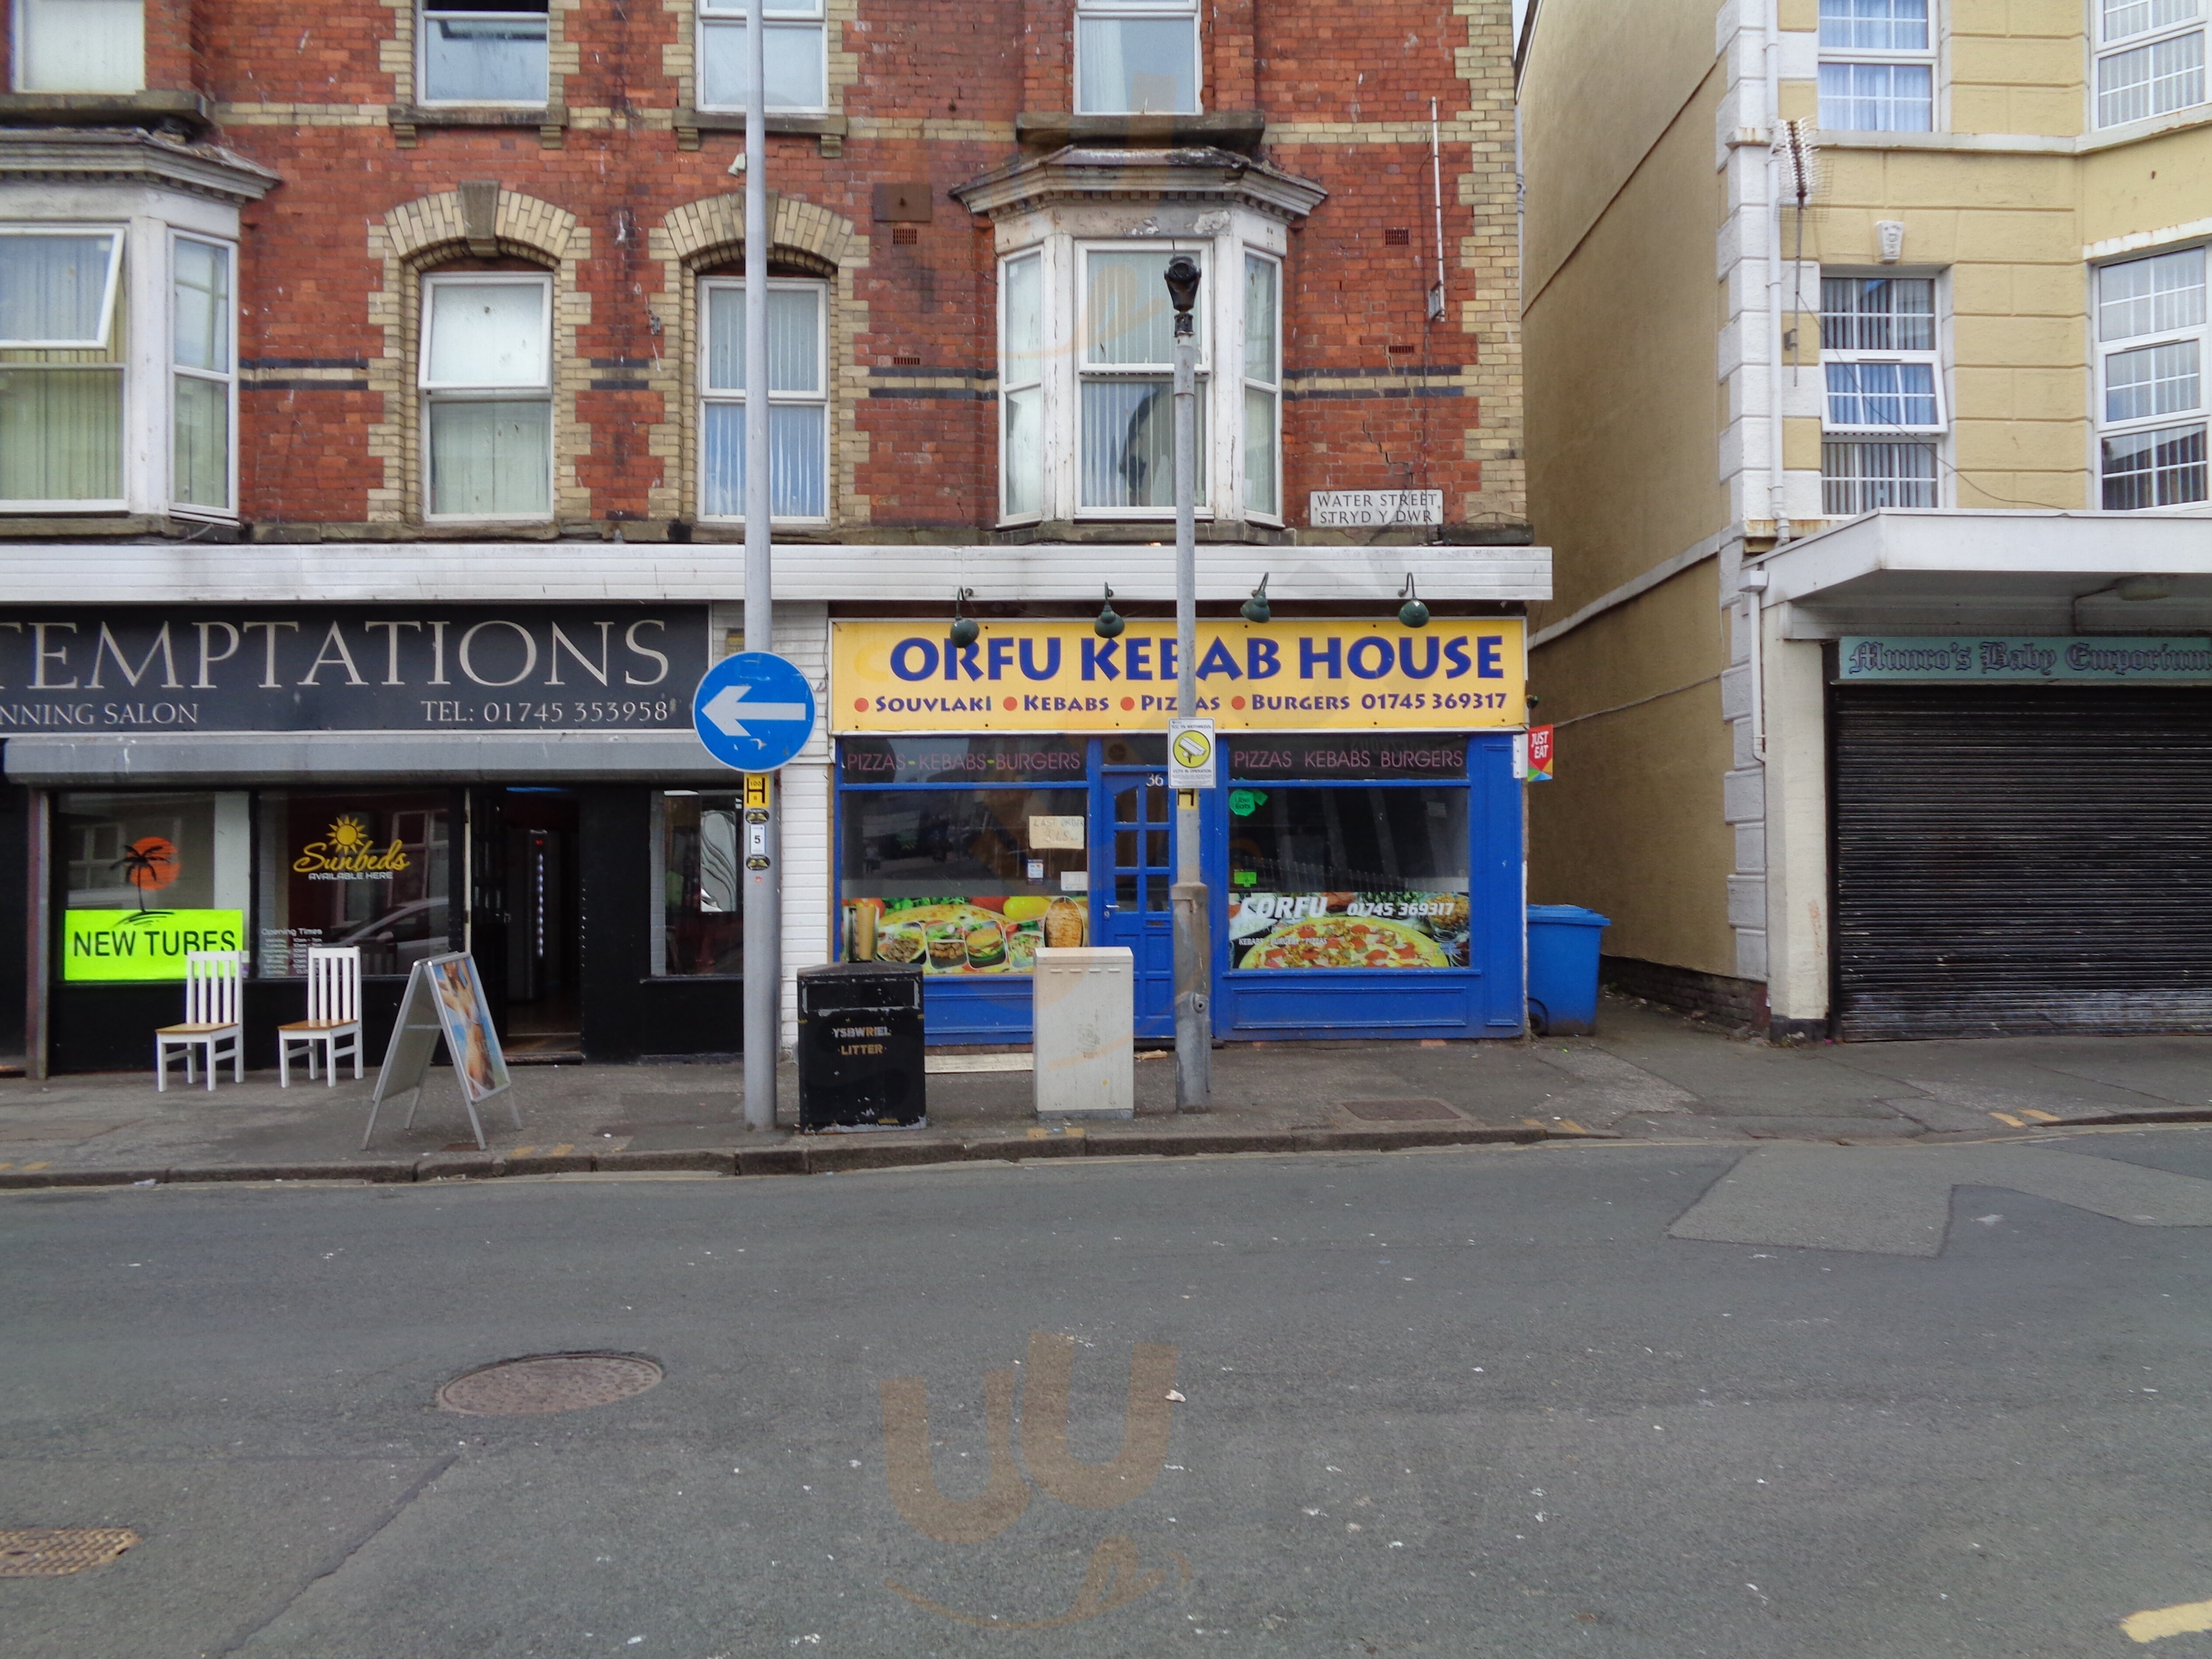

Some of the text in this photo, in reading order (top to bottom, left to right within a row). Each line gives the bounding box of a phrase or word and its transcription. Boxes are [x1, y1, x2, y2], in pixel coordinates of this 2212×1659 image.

[1317, 494, 1437, 507] WATER STREET
[1320, 510, 1433, 523] STRYD Y DWR
[1299, 635, 1504, 680] HOUSE
[1979, 641, 2057, 675] Baby
[876, 692, 1507, 712] SOUVLAKI KEBABS PIZAS BURGERS 01745 369317
[104, 702, 199, 725] SALON
[421, 701, 668, 722] TEL: 01745 353958
[1531, 731, 1549, 748] JUST
[1234, 750, 1464, 768] PIZZAS KEBABS BURGERS
[1534, 745, 1549, 759] EAT
[847, 752, 1080, 771] PIZZAS KEBABS BURGERS
[1146, 773, 1164, 787] 36
[754, 835, 761, 844] 5
[293, 839, 411, 873] Sunbeds
[308, 871, 393, 881] AVAILABLE HERE
[1240, 896, 1455, 919] CORFU 01745 369317
[73, 930, 136, 956] NEW
[148, 930, 236, 956] TUBES
[832, 1026, 892, 1038] YSBWRIEL
[841, 1043, 883, 1056] LITTER
